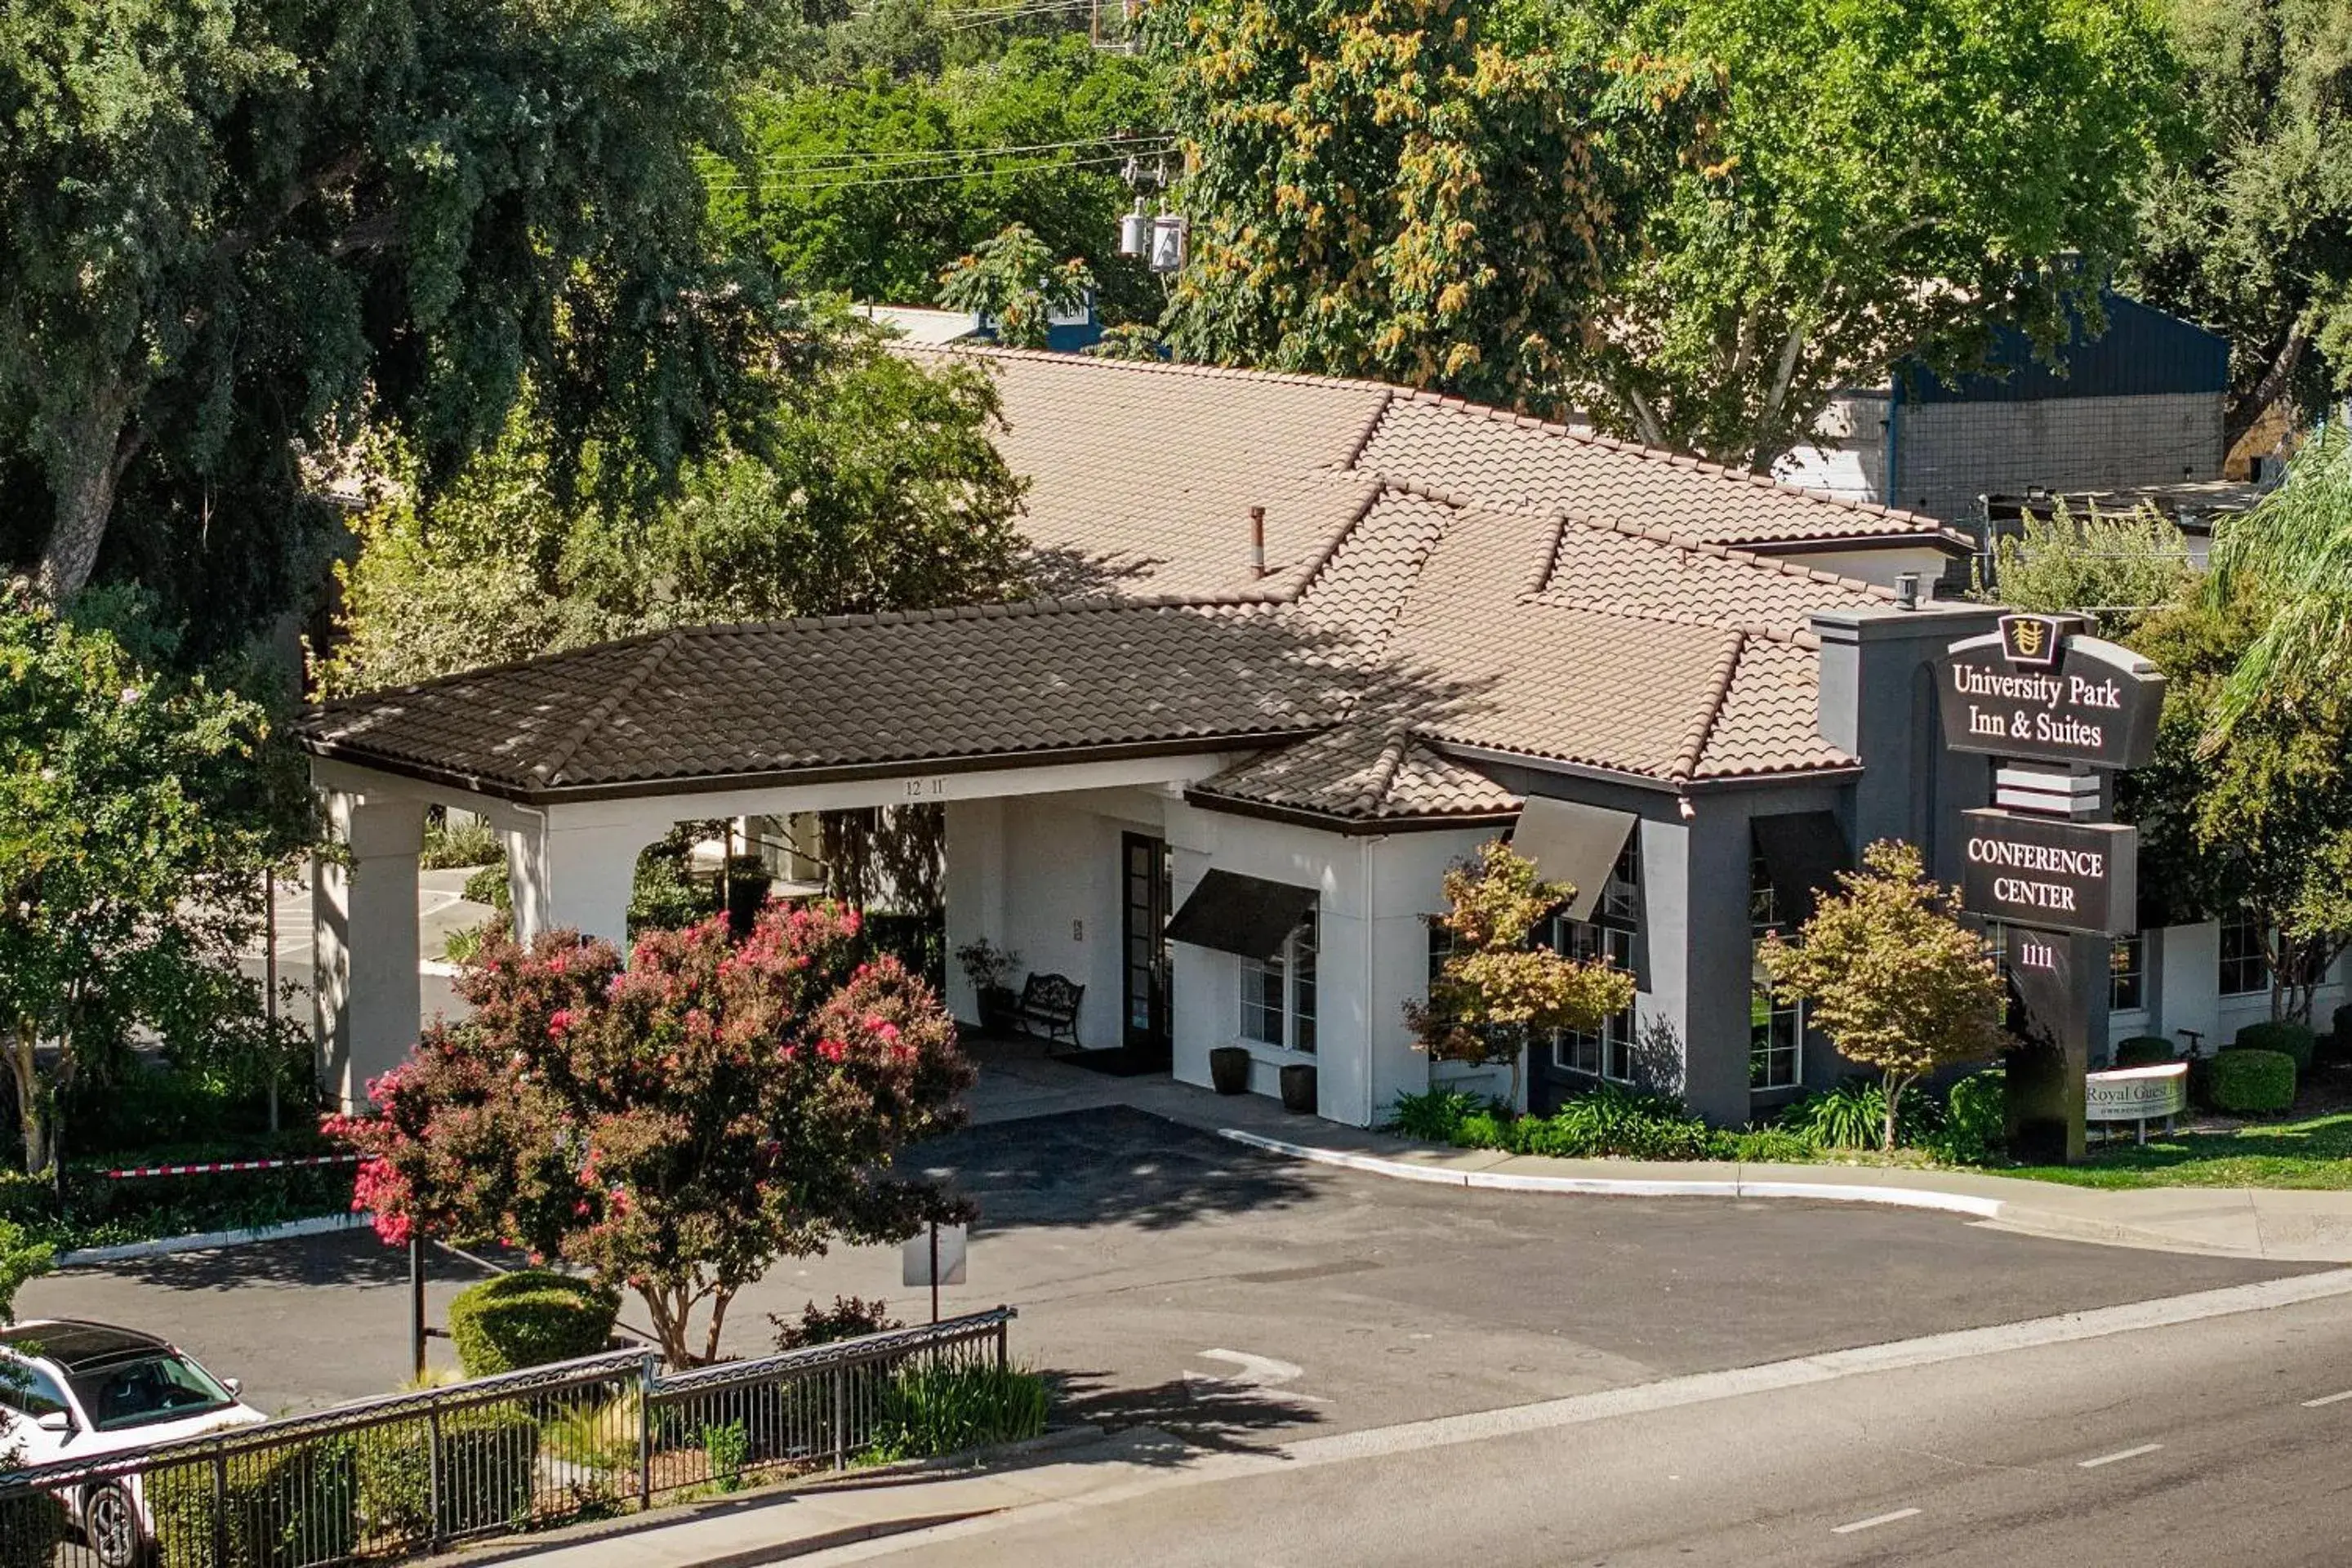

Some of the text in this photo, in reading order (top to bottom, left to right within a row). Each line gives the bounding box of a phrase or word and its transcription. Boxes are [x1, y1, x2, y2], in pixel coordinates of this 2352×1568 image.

[1953, 664, 2121, 710] University Park
[1969, 705, 2102, 747] Inn & Suites
[1968, 838, 2104, 878] CONFERENCE
[1993, 877, 2077, 911] CENTER
[2021, 942, 2054, 969] 1111
[2087, 1086, 2129, 1104] Royal
